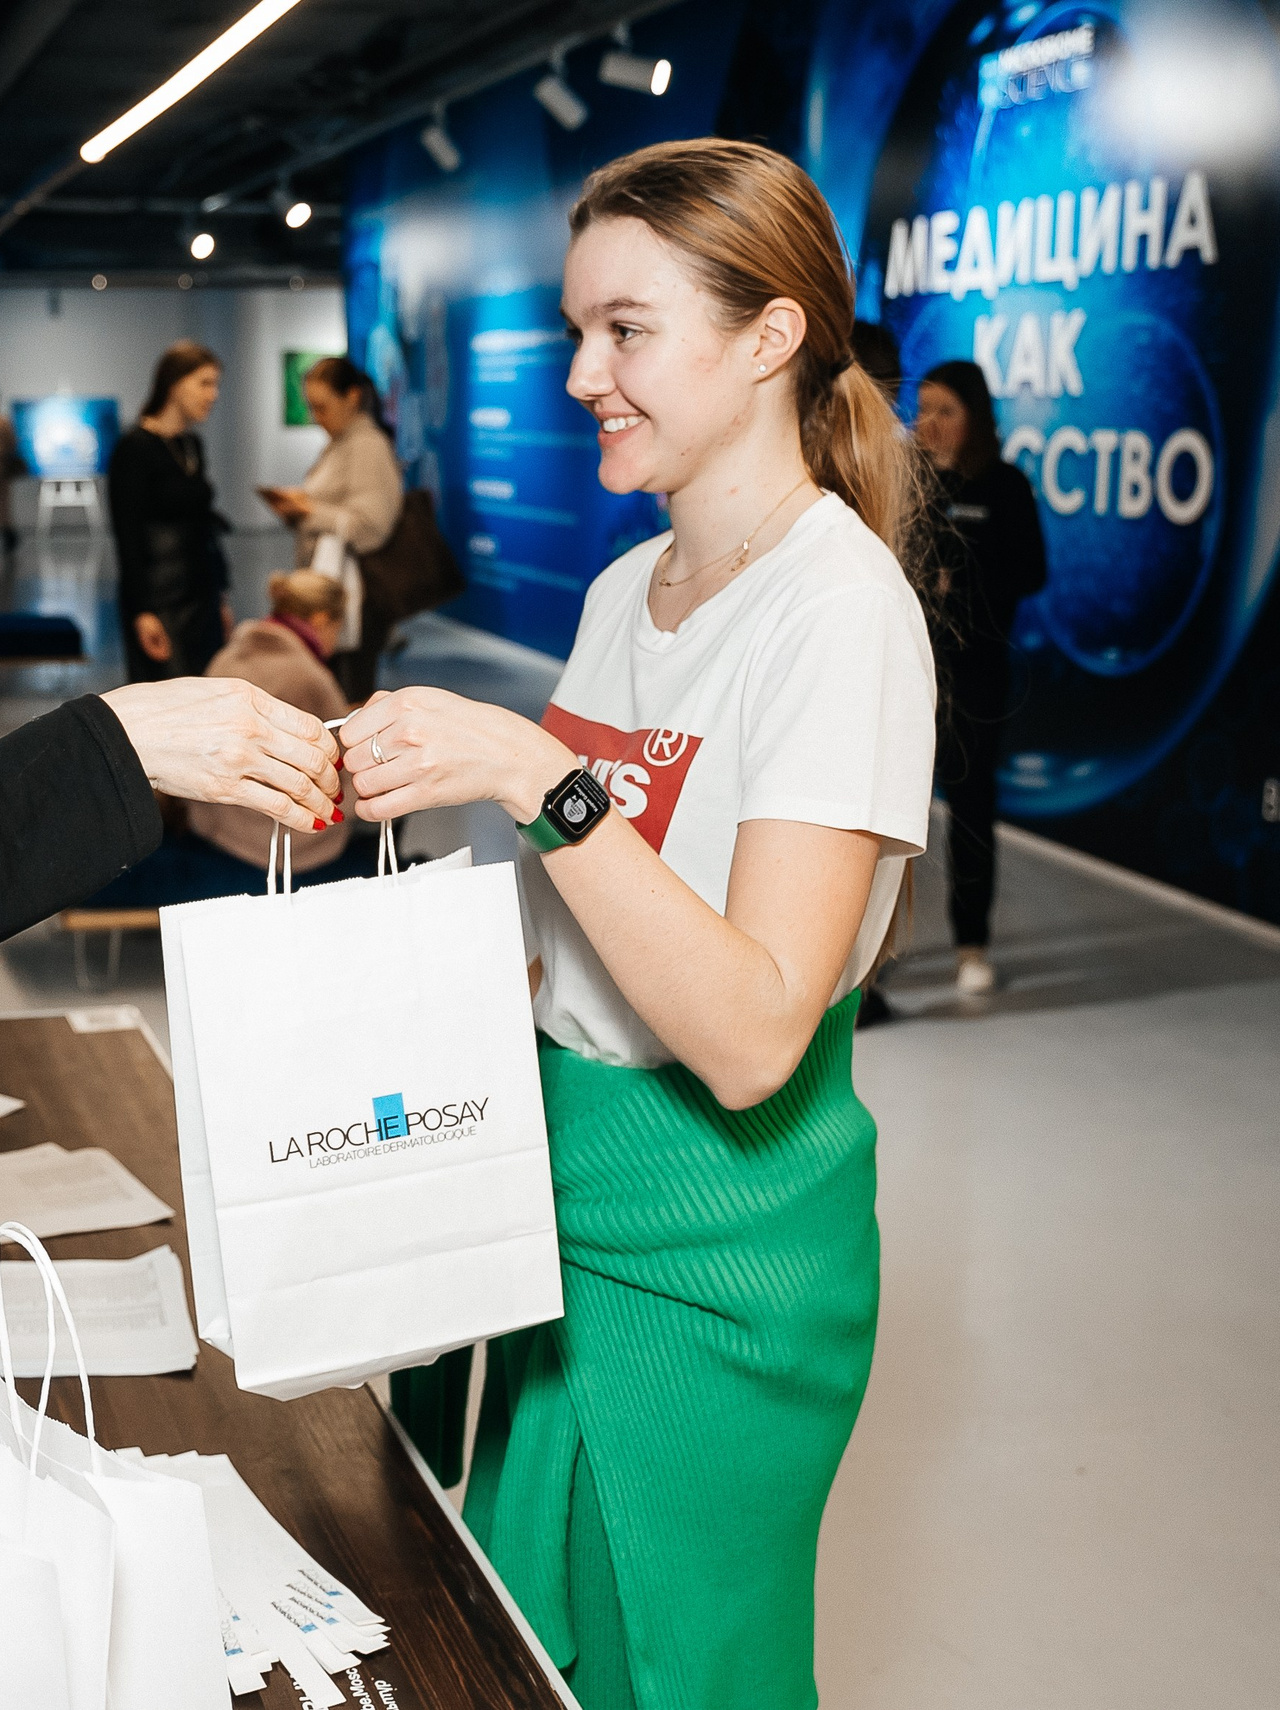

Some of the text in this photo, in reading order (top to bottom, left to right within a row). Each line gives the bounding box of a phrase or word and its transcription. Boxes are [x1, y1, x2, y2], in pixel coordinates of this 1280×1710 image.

[884, 170, 1218, 301] МЕДИЦИНА
[973, 308, 1087, 399] КАК
[269, 1097, 489, 1163] LA ROCHE POSAY
[309, 1145, 382, 1169] LABORATOIRE
